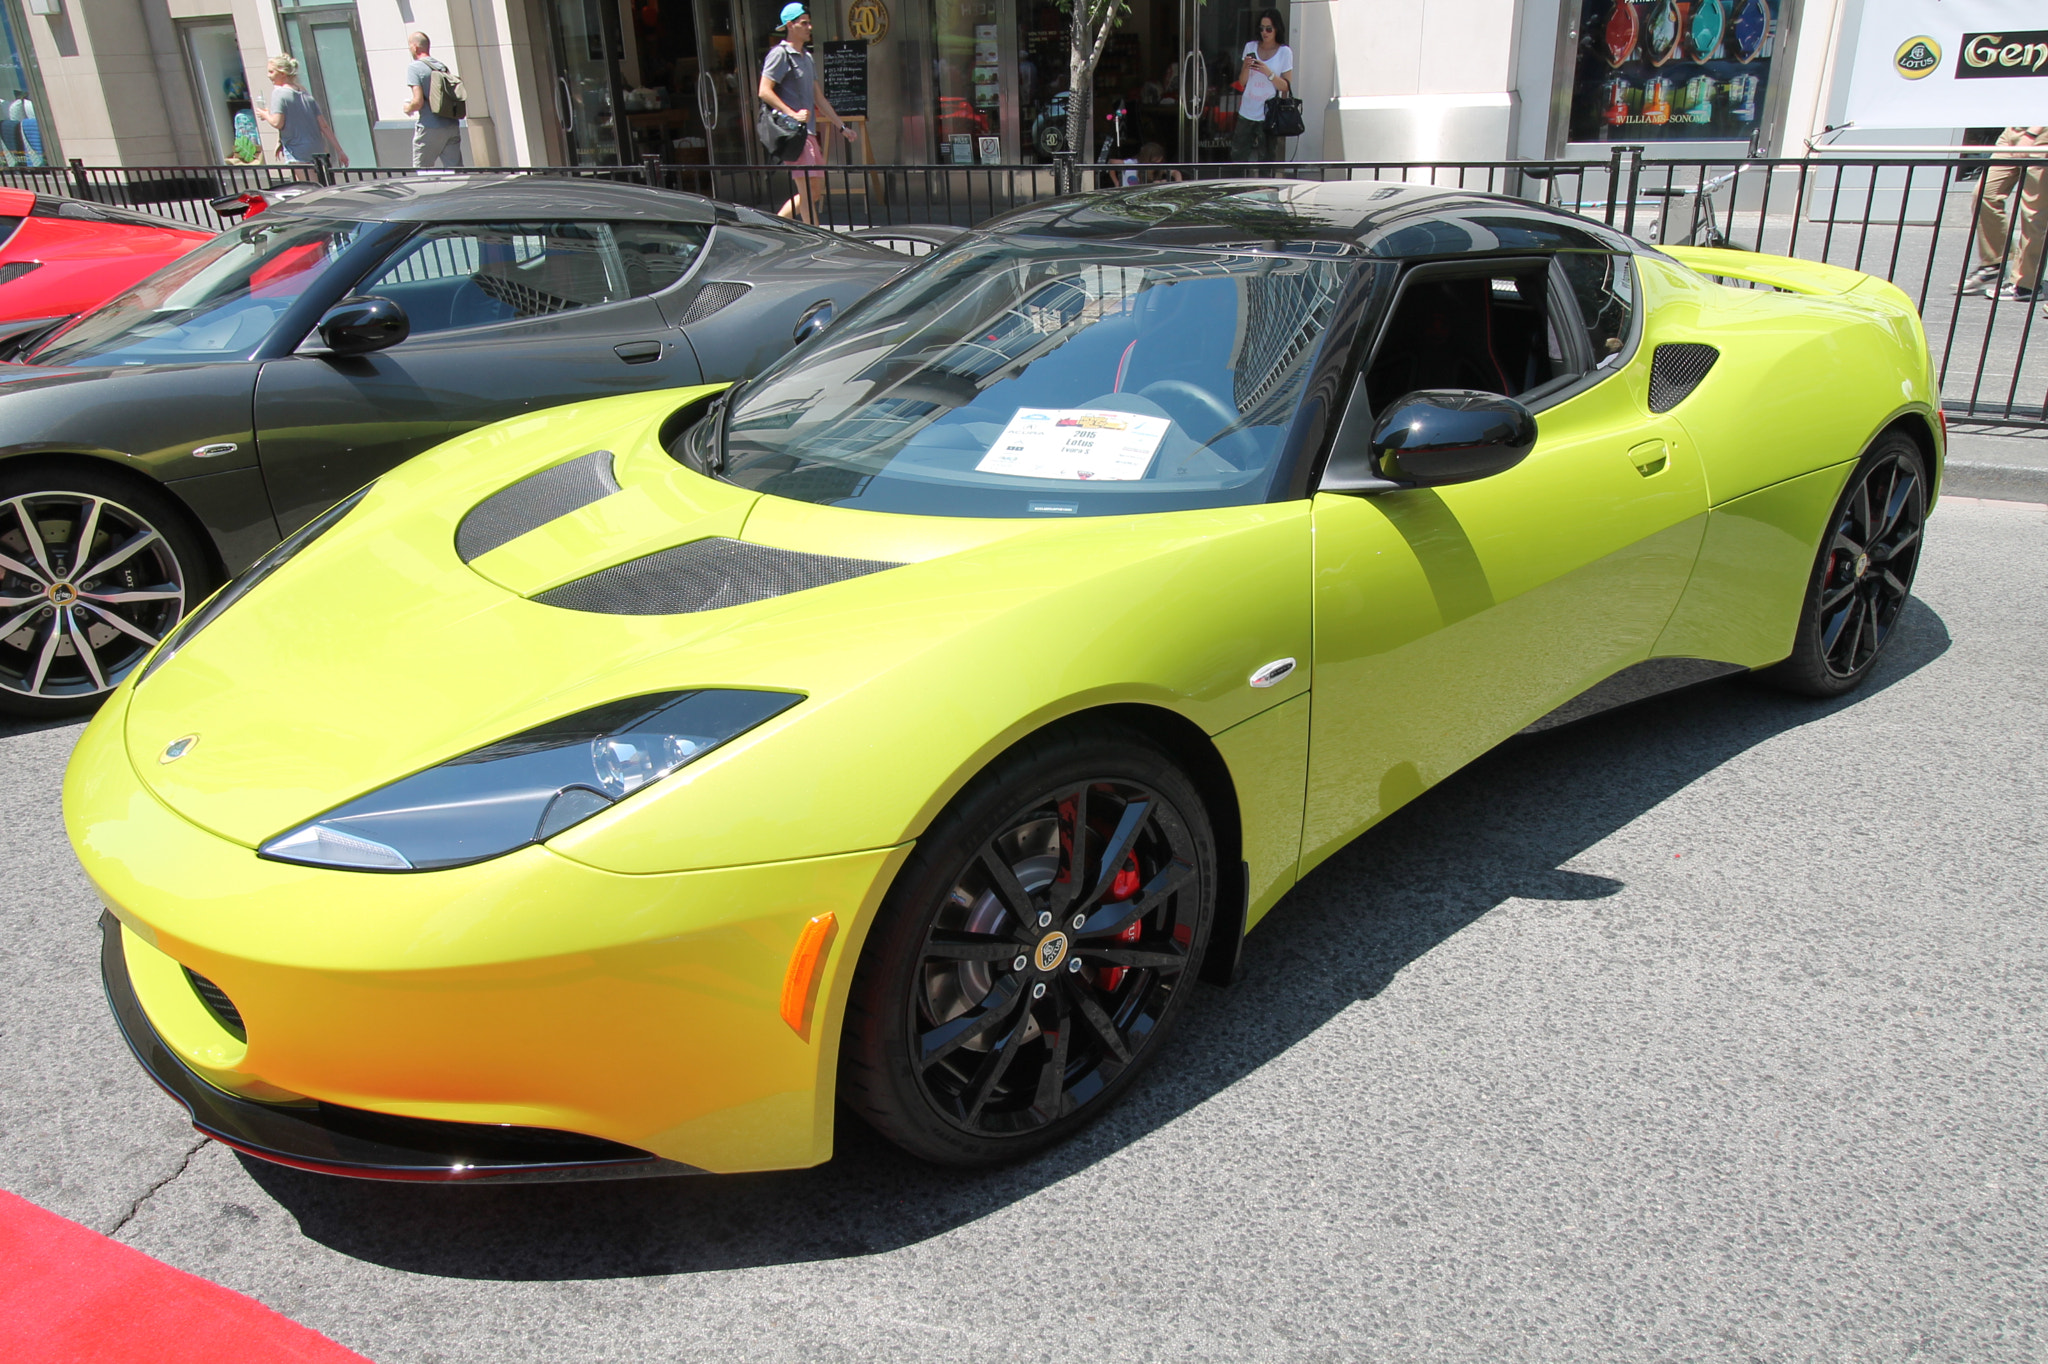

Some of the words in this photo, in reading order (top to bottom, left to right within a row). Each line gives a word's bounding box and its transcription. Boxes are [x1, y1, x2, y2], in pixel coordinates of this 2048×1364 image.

[1899, 57, 1934, 68] LOTUS
[1073, 430, 1097, 439] 2015
[1066, 438, 1094, 448] Lotus
[1044, 939, 1062, 967] LOTUS
